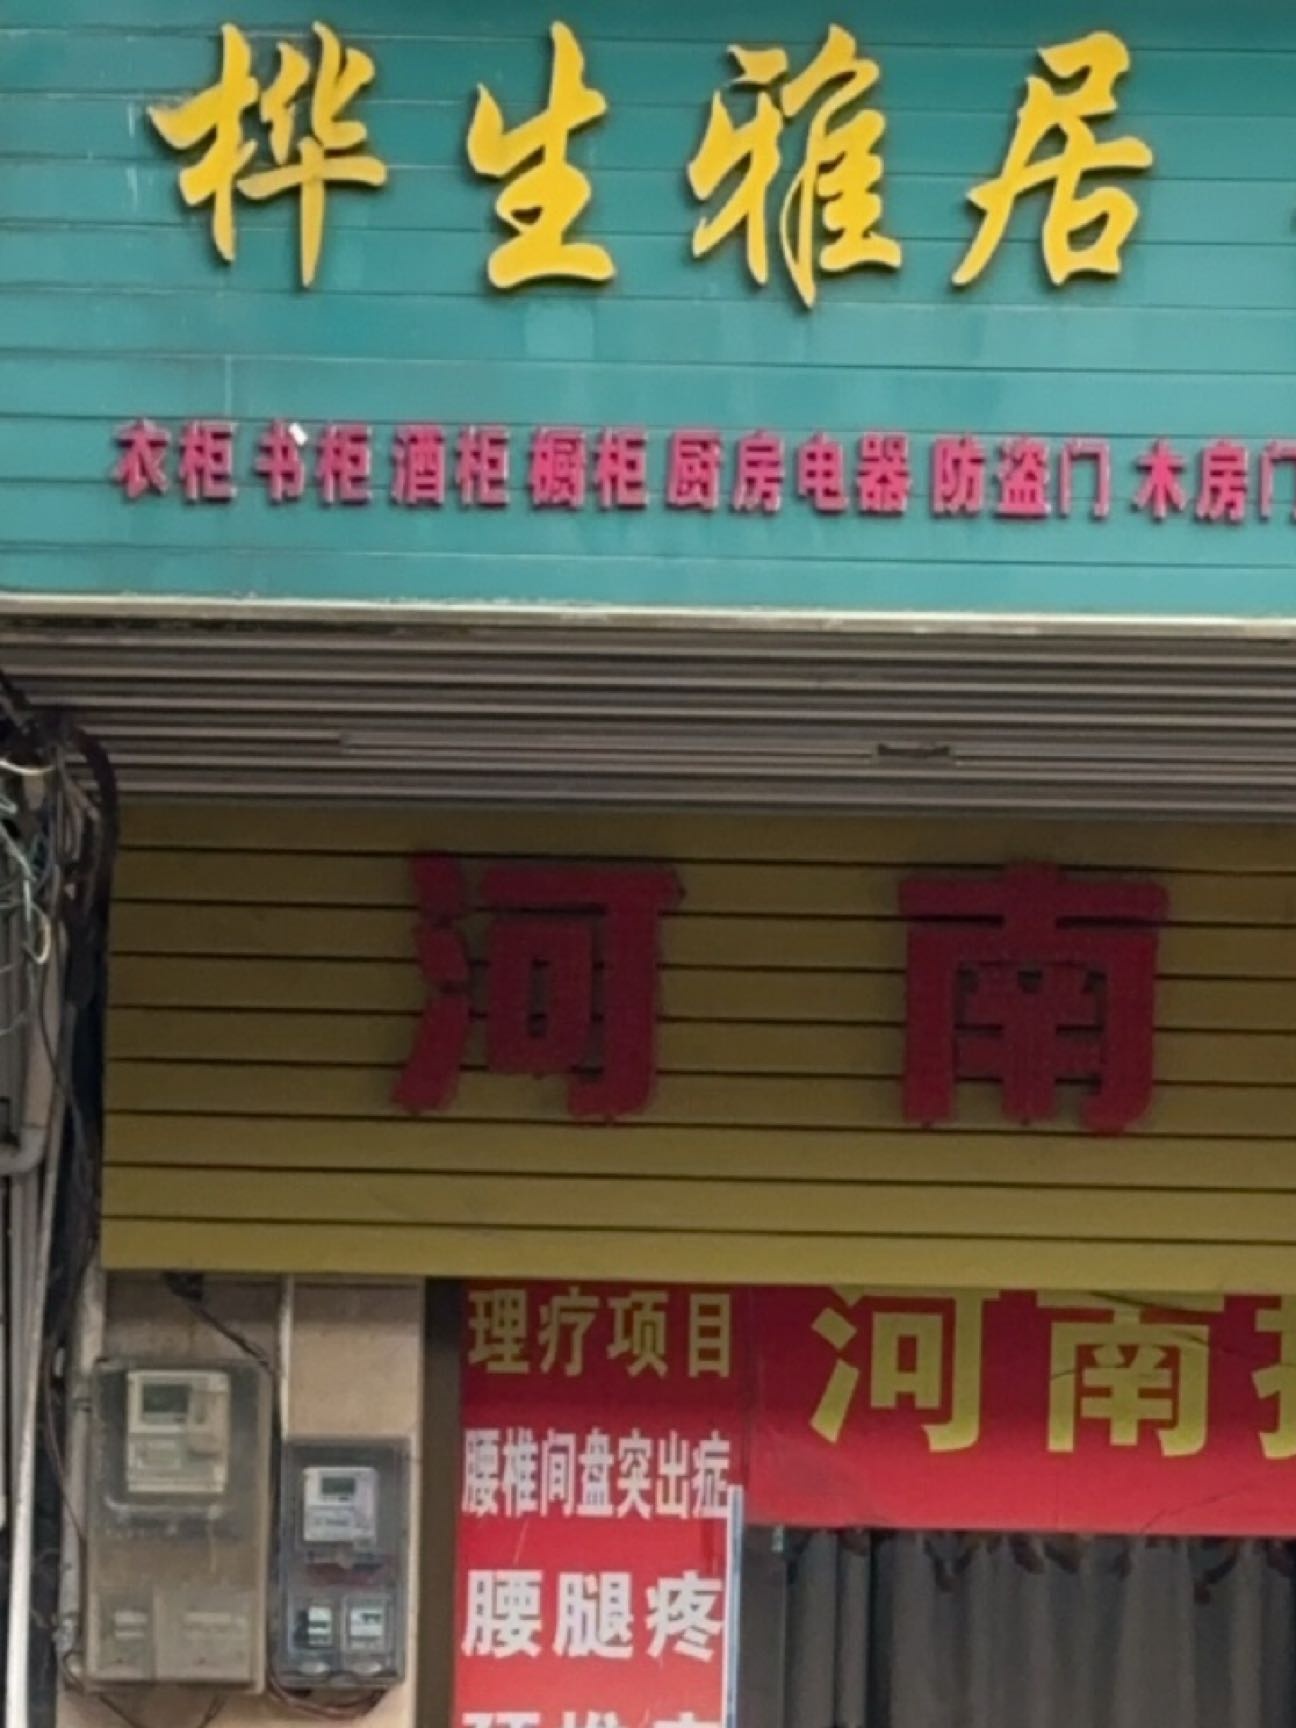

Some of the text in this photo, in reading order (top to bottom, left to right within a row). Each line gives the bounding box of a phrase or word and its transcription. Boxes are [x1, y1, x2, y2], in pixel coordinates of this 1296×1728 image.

[149, 20, 1155, 308] 桦生雅居
[113, 417, 236, 499] 衣柜
[254, 419, 371, 501] 书柜
[391, 422, 509, 506] 酒柜
[529, 424, 648, 509] 橱柜
[666, 427, 911, 515] 厨房电器
[931, 433, 1110, 519] 防盗门
[468, 1287, 731, 1378] 理疗项目
[461, 1427, 733, 1520] 腰椎间盘突出症
[461, 1568, 722, 1662] 腰腿疼
